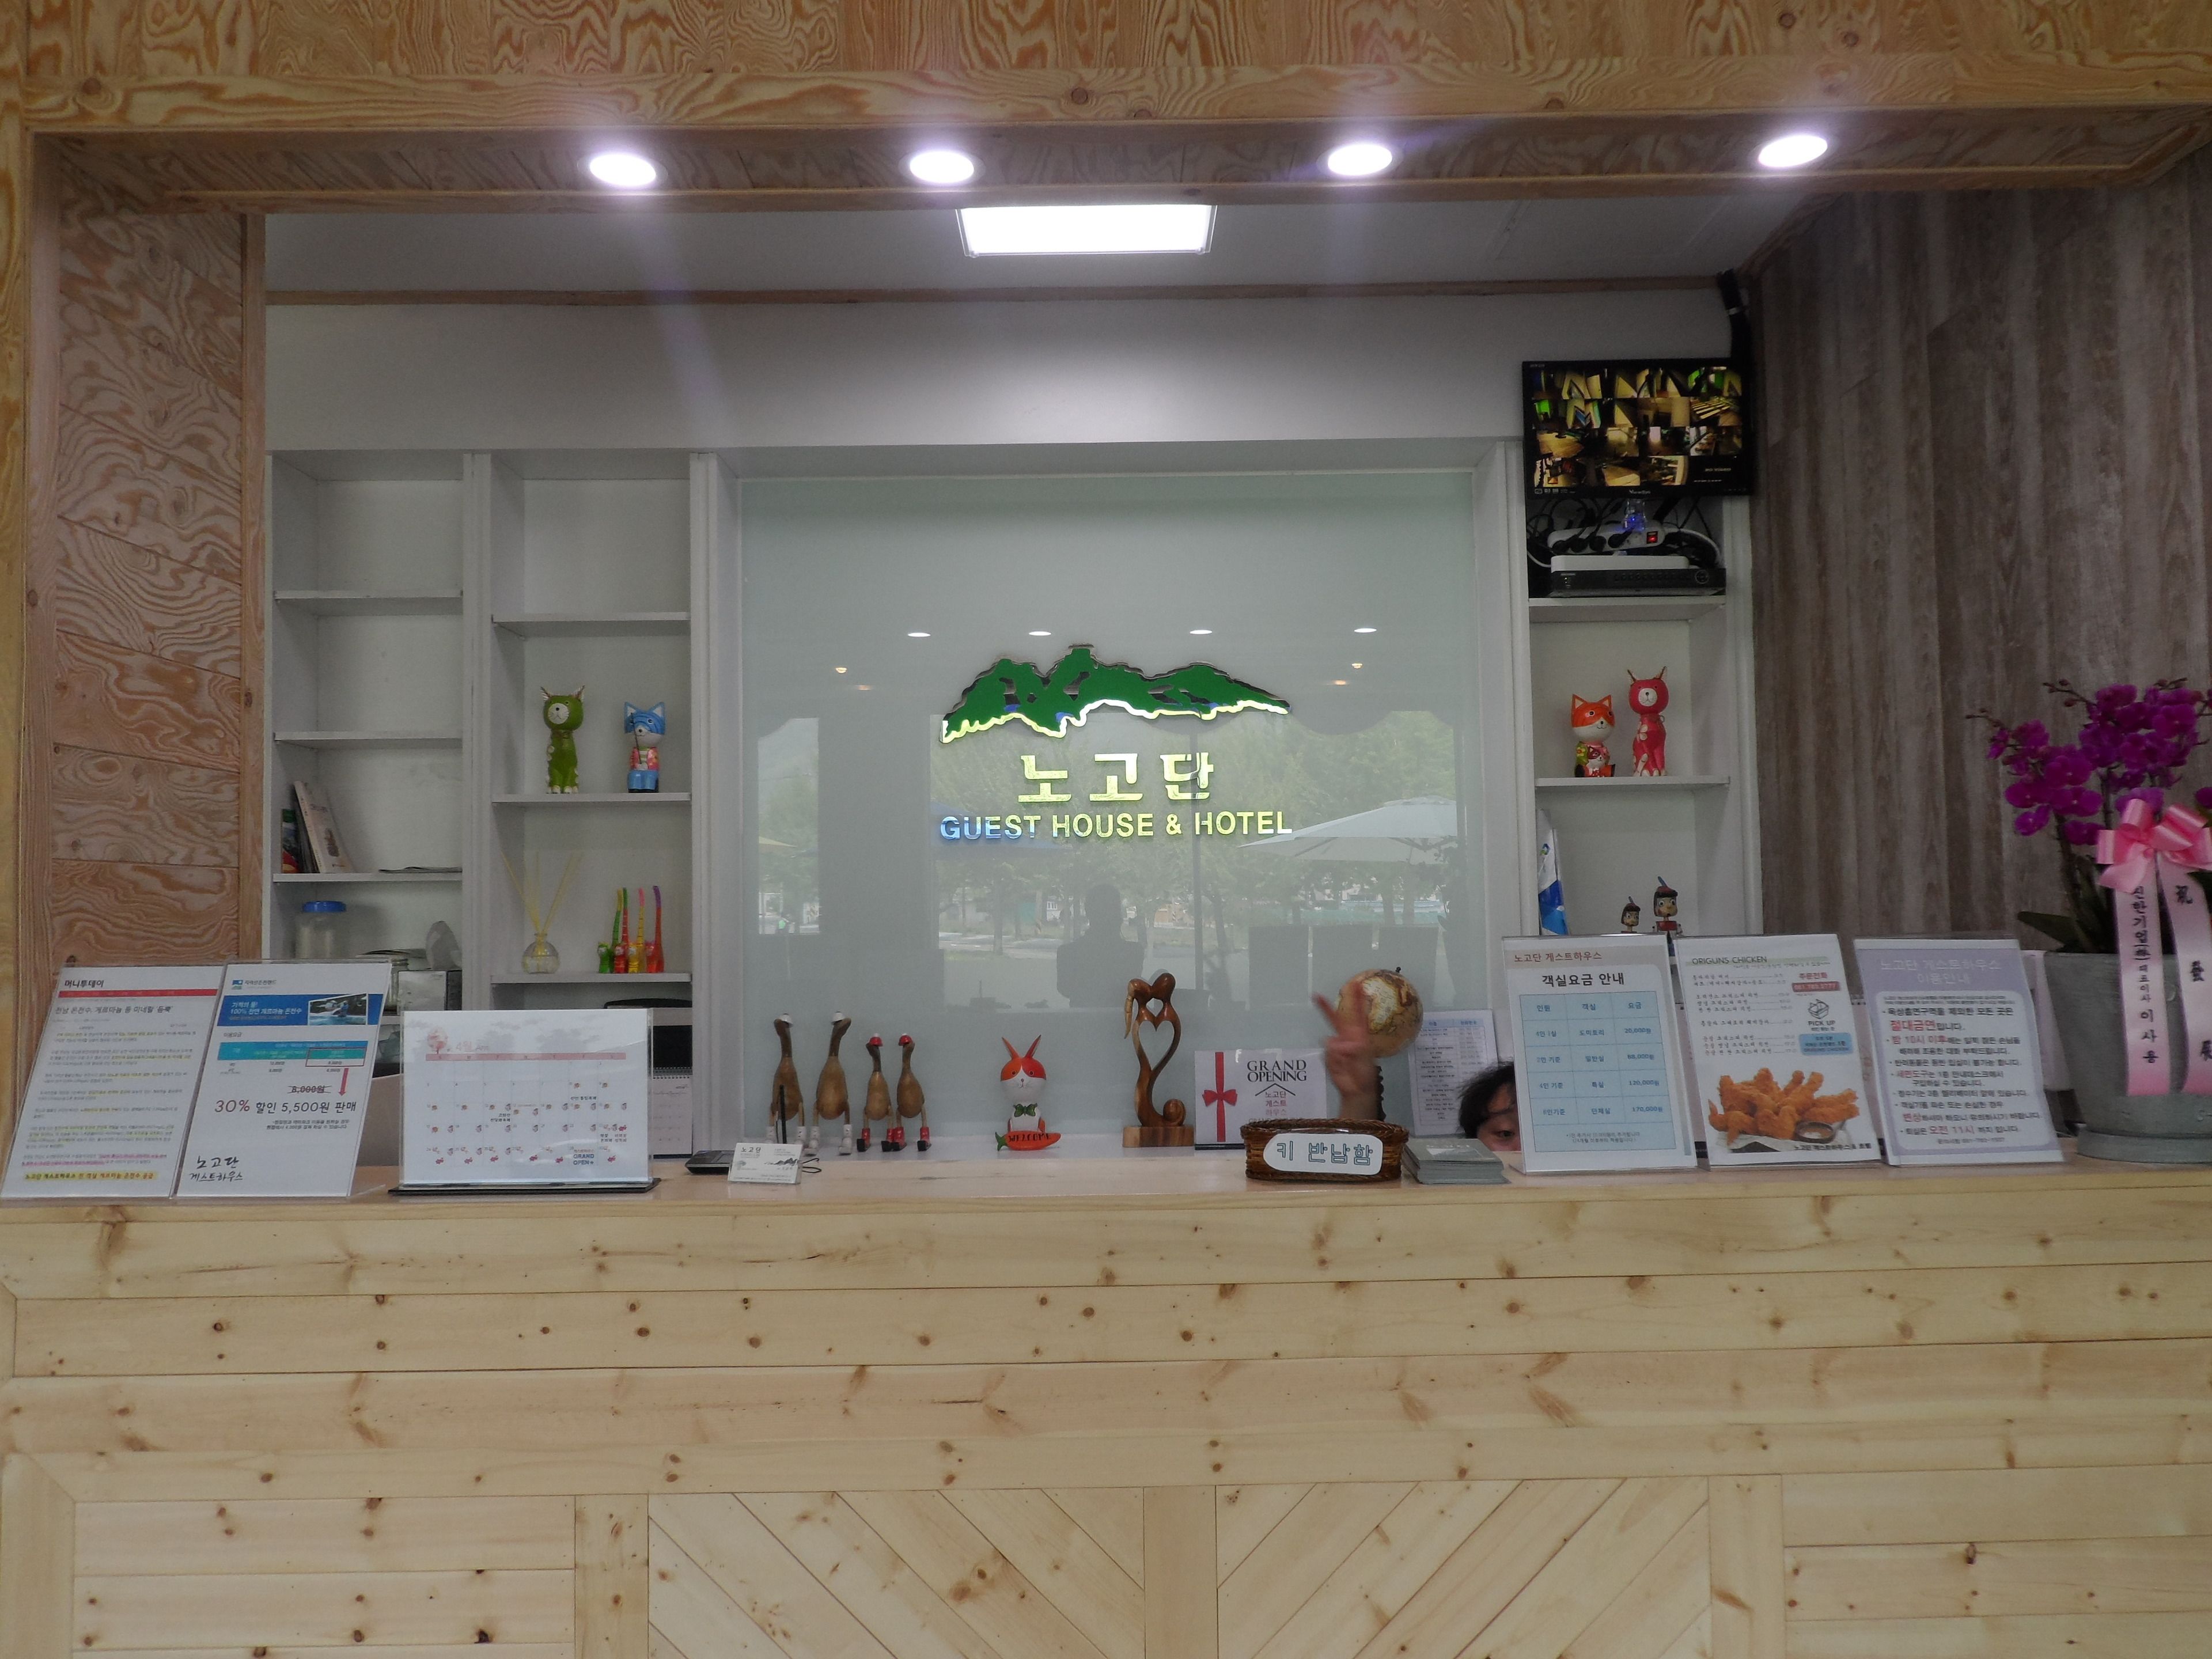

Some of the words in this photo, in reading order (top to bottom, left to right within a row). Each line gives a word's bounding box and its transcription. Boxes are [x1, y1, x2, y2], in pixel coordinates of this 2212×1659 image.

[1018, 751, 1214, 802] 노고단
[940, 813, 1041, 840] GUEST
[1052, 812, 1153, 838] HOUSE
[1166, 813, 1183, 836] &
[1195, 810, 1293, 836] HOTEL
[1514, 953, 1541, 963] 노고단
[1546, 952, 1602, 961] 게스트하우스
[1880, 960, 1918, 971] 노고단
[65, 980, 105, 988] 머니투데이
[1542, 974, 1593, 987] 객실요금
[1599, 972, 1624, 985] 안내
[1917, 973, 1971, 984] 이용안내
[1628, 1002, 1642, 1010] 요금
[1890, 1020, 1965, 1031] 절대금연입니다.
[1905, 1035, 1925, 1044] 10시
[1247, 1059, 1306, 1071] GRAND
[1247, 1071, 1306, 1082] OPENING
[215, 1099, 250, 1113] 30%
[256, 1102, 277, 1114] 할인
[282, 1102, 330, 1115] 5,500원
[335, 1101, 357, 1114] 판매
[1930, 1126, 1949, 1135] 오전
[1952, 1126, 1975, 1134] 11시
[1277, 1140, 1293, 1161] 키
[1308, 1142, 1373, 1166] 반납함
[196, 1156, 240, 1169] 노고단
[189, 1171, 244, 1183] 게스트하우스
